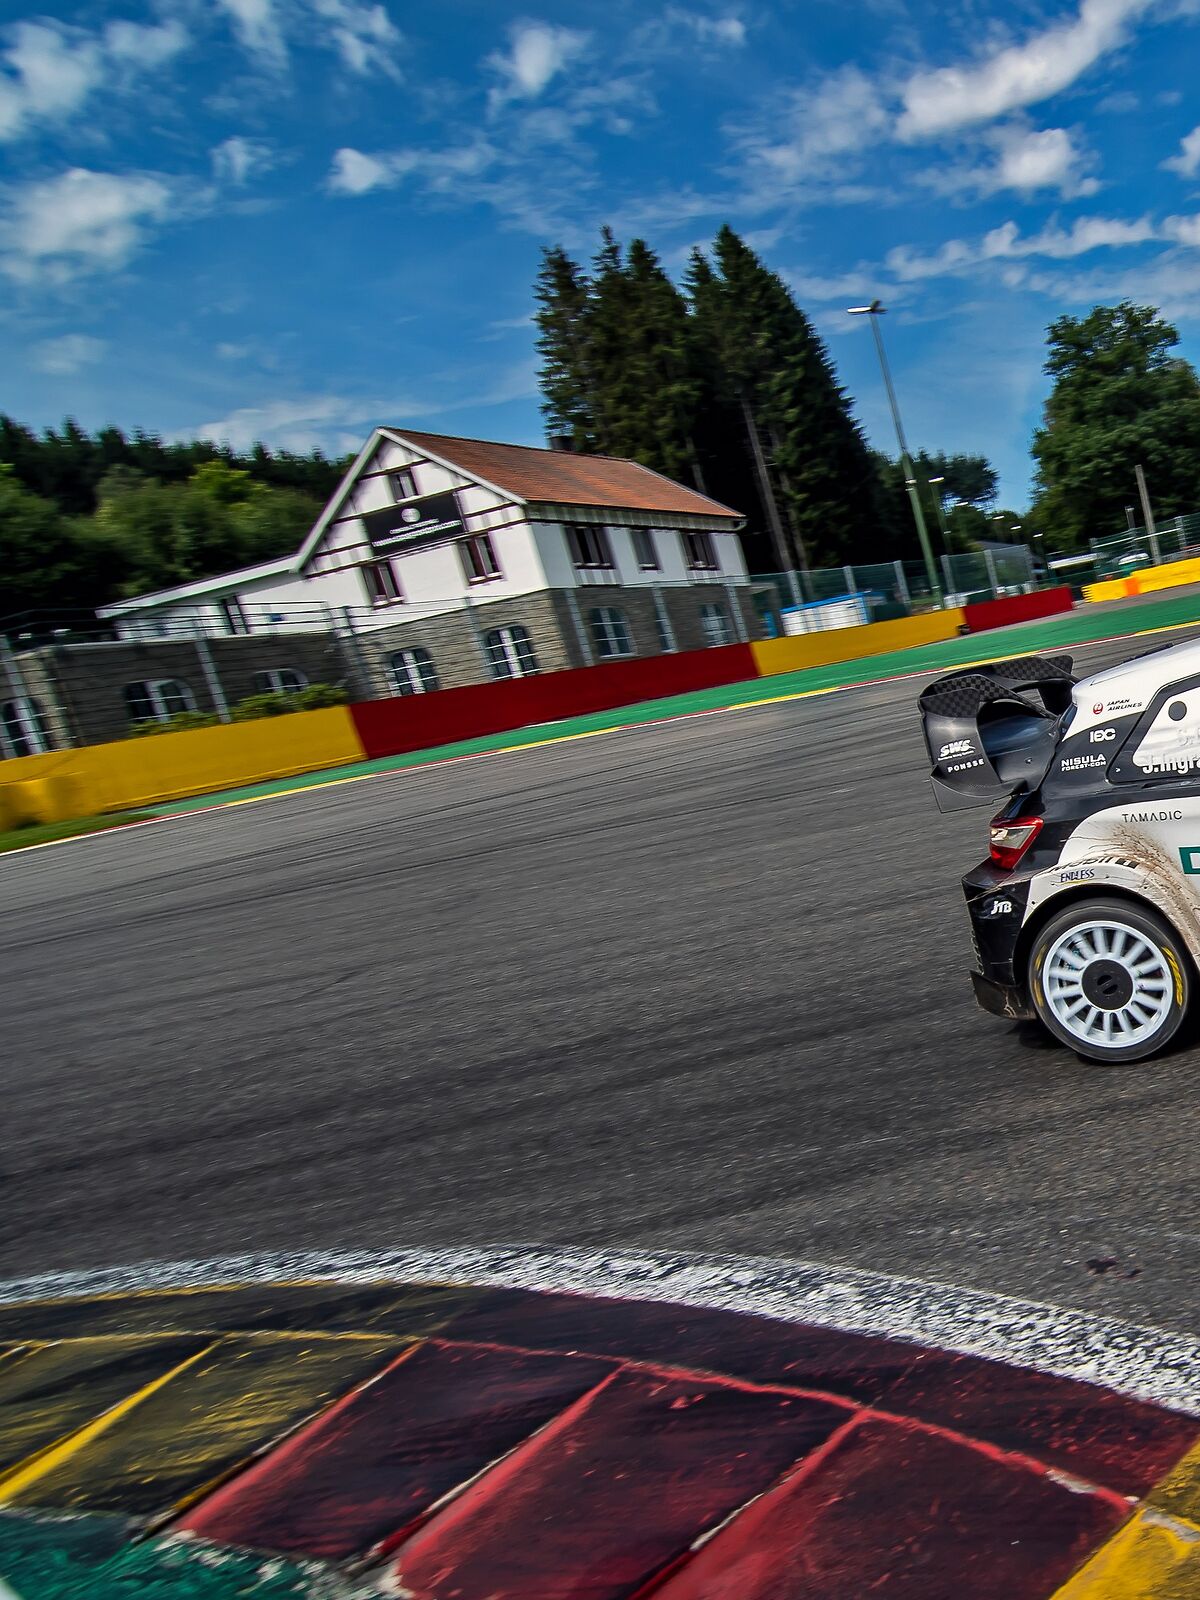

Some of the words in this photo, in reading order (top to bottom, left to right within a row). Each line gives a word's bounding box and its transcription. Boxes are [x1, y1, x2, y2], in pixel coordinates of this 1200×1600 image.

[1106, 698, 1130, 706] JAPAN
[1107, 702, 1143, 712] AIRLINES
[940, 739, 971, 758] SWS
[947, 758, 985, 773] PONSSE
[1061, 753, 1106, 767] NISULA
[1121, 810, 1183, 823] TAMADIC
[1060, 869, 1095, 883] ENDLESS
[990, 900, 1012, 915] JTB
